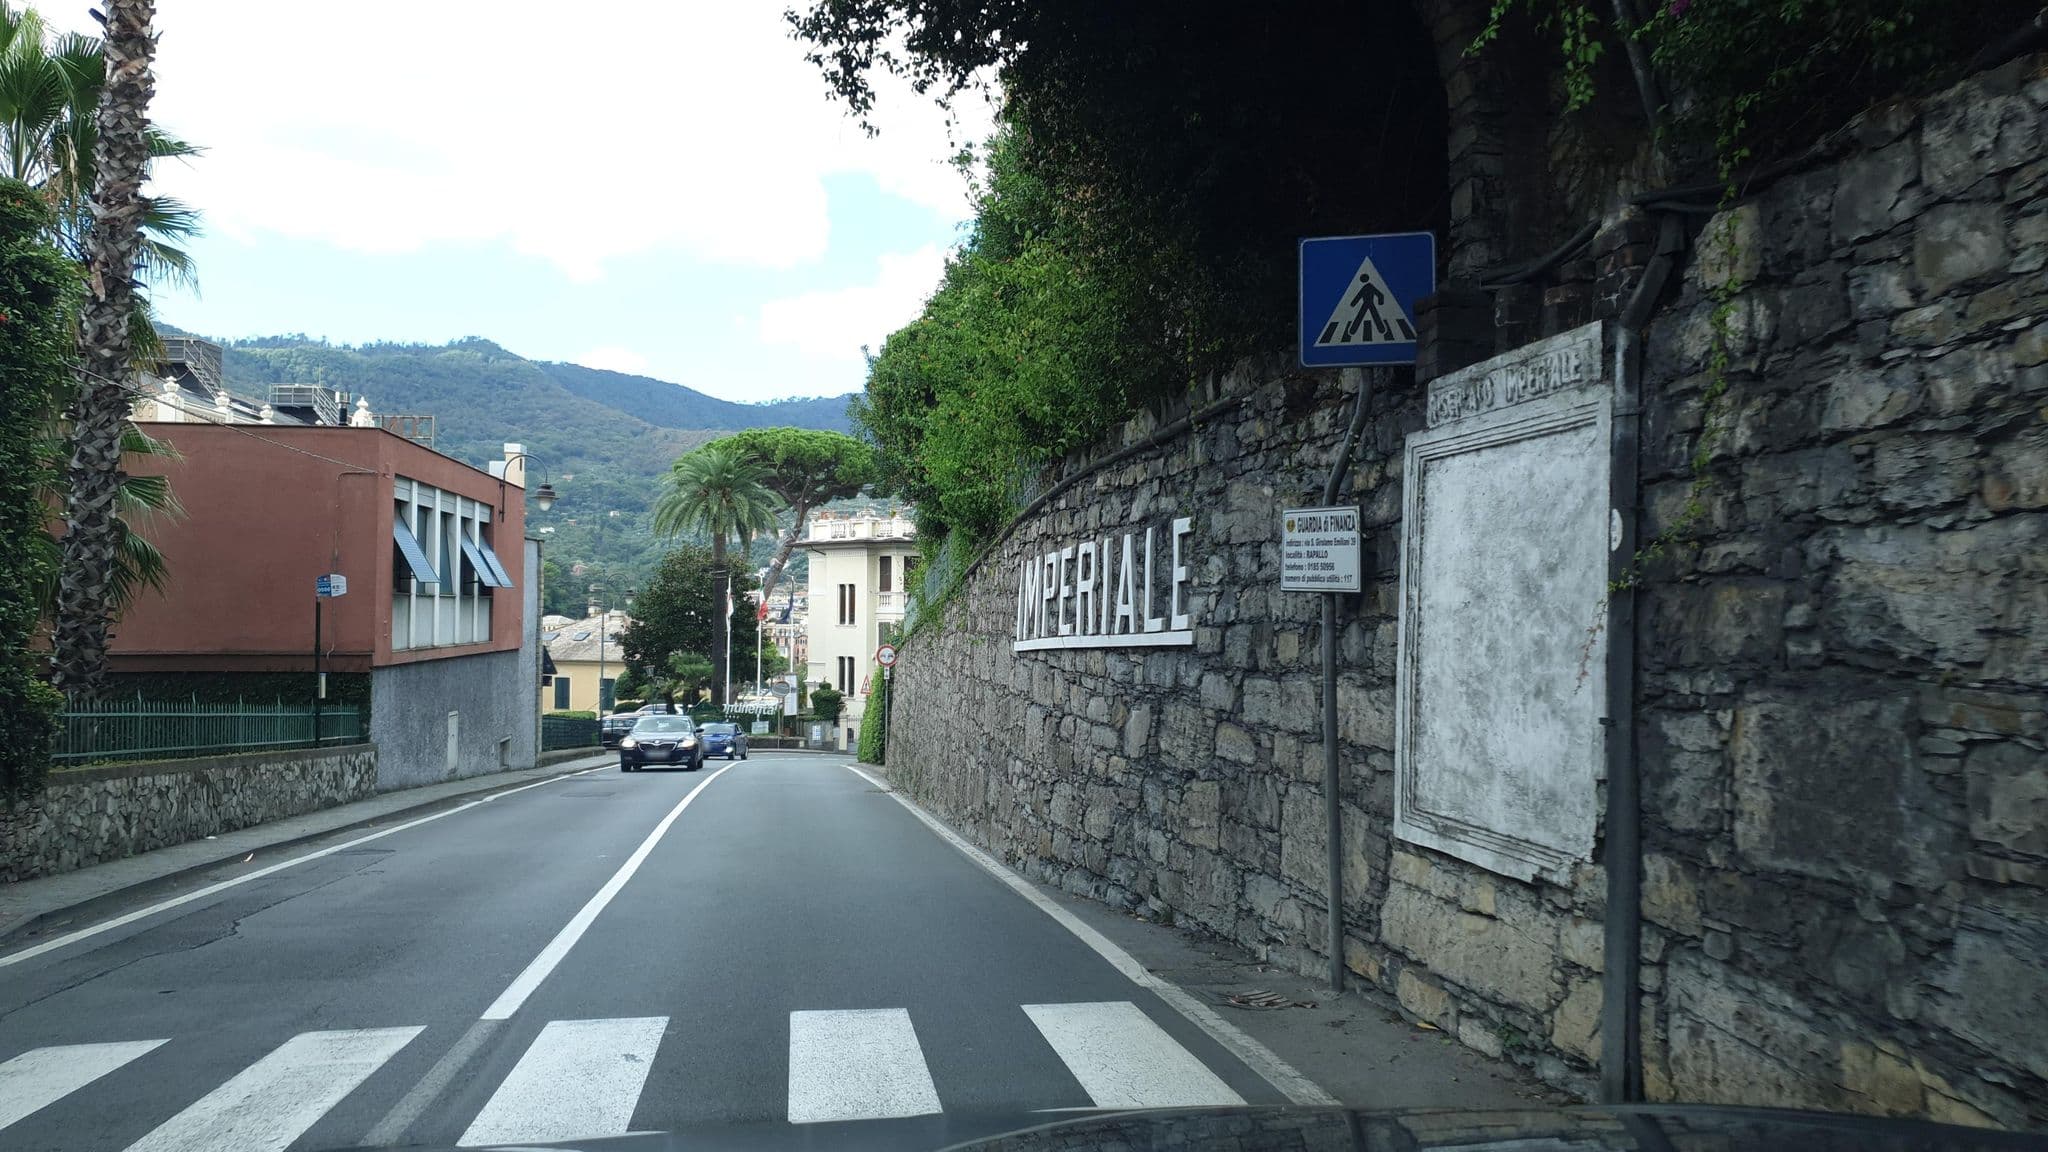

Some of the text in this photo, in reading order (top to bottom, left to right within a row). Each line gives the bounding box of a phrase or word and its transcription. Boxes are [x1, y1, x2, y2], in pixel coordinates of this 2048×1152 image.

[1297, 514, 1356, 533] GUARDIA di FINANZA
[1306, 550, 1328, 559] RAPALLO
[1016, 516, 1193, 642] IMPERIALE
